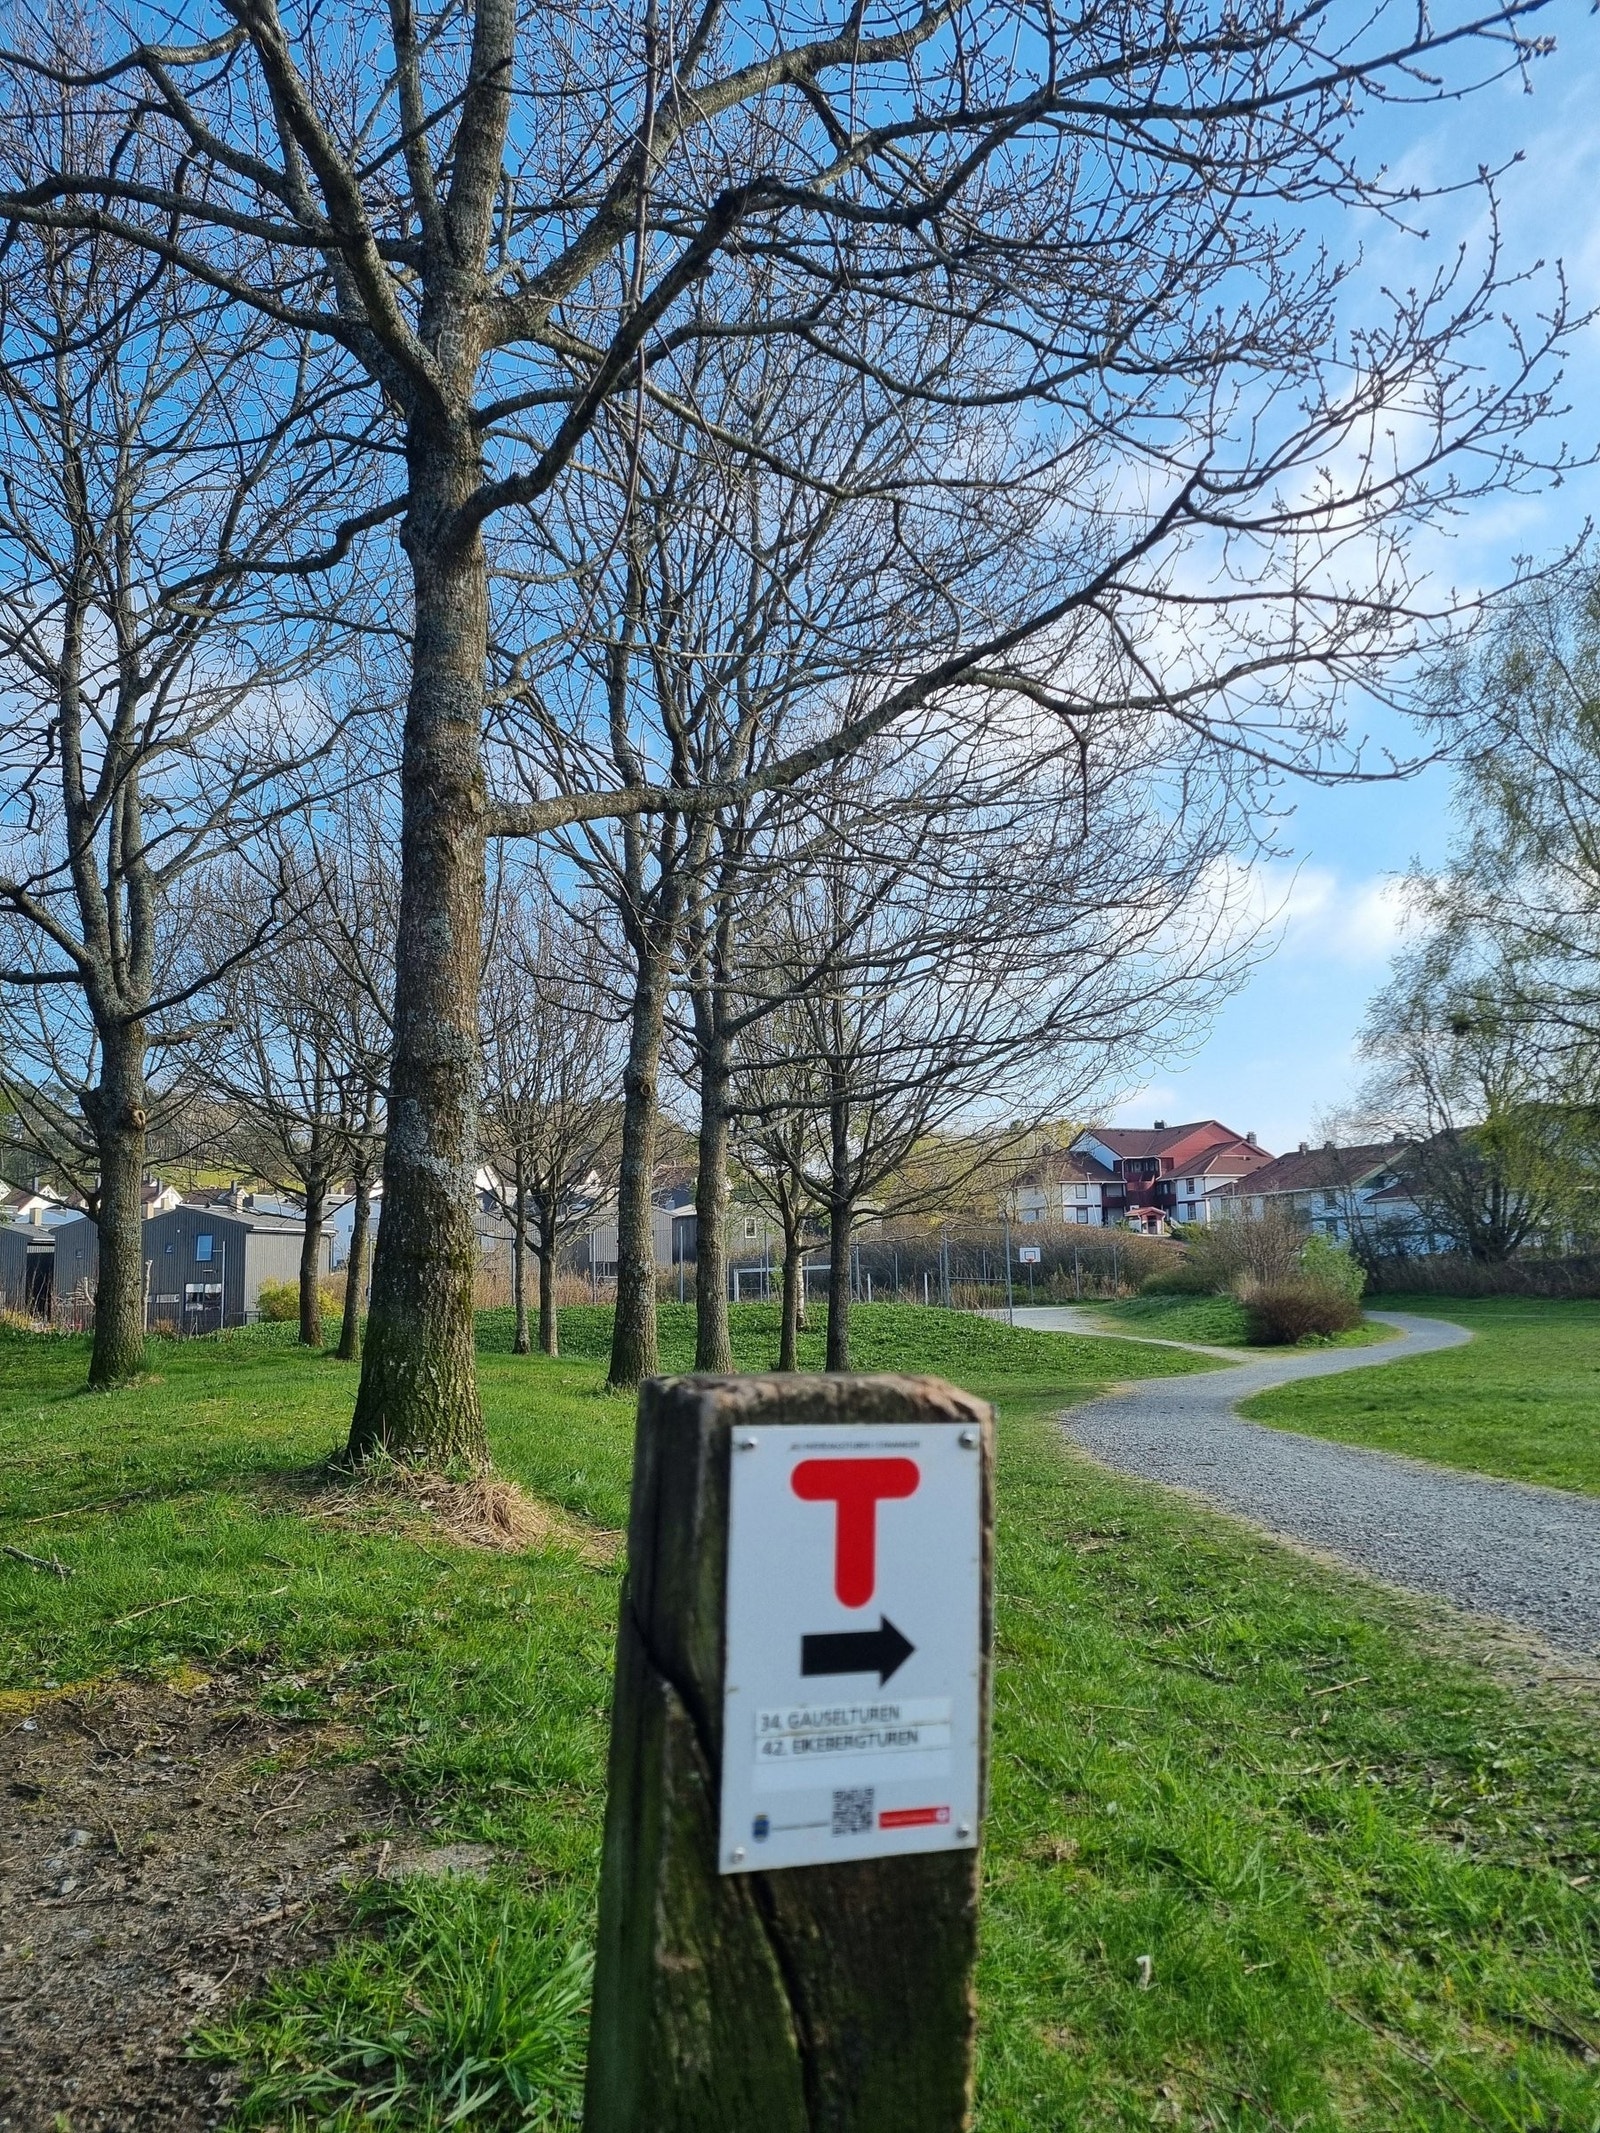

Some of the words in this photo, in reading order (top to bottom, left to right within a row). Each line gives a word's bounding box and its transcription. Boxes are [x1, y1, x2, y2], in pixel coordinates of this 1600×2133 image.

[791, 1458, 920, 1609] T
[787, 1704, 900, 1729] GAUSELTUREN
[792, 1729, 919, 1754] EIKEBERGTUREN
